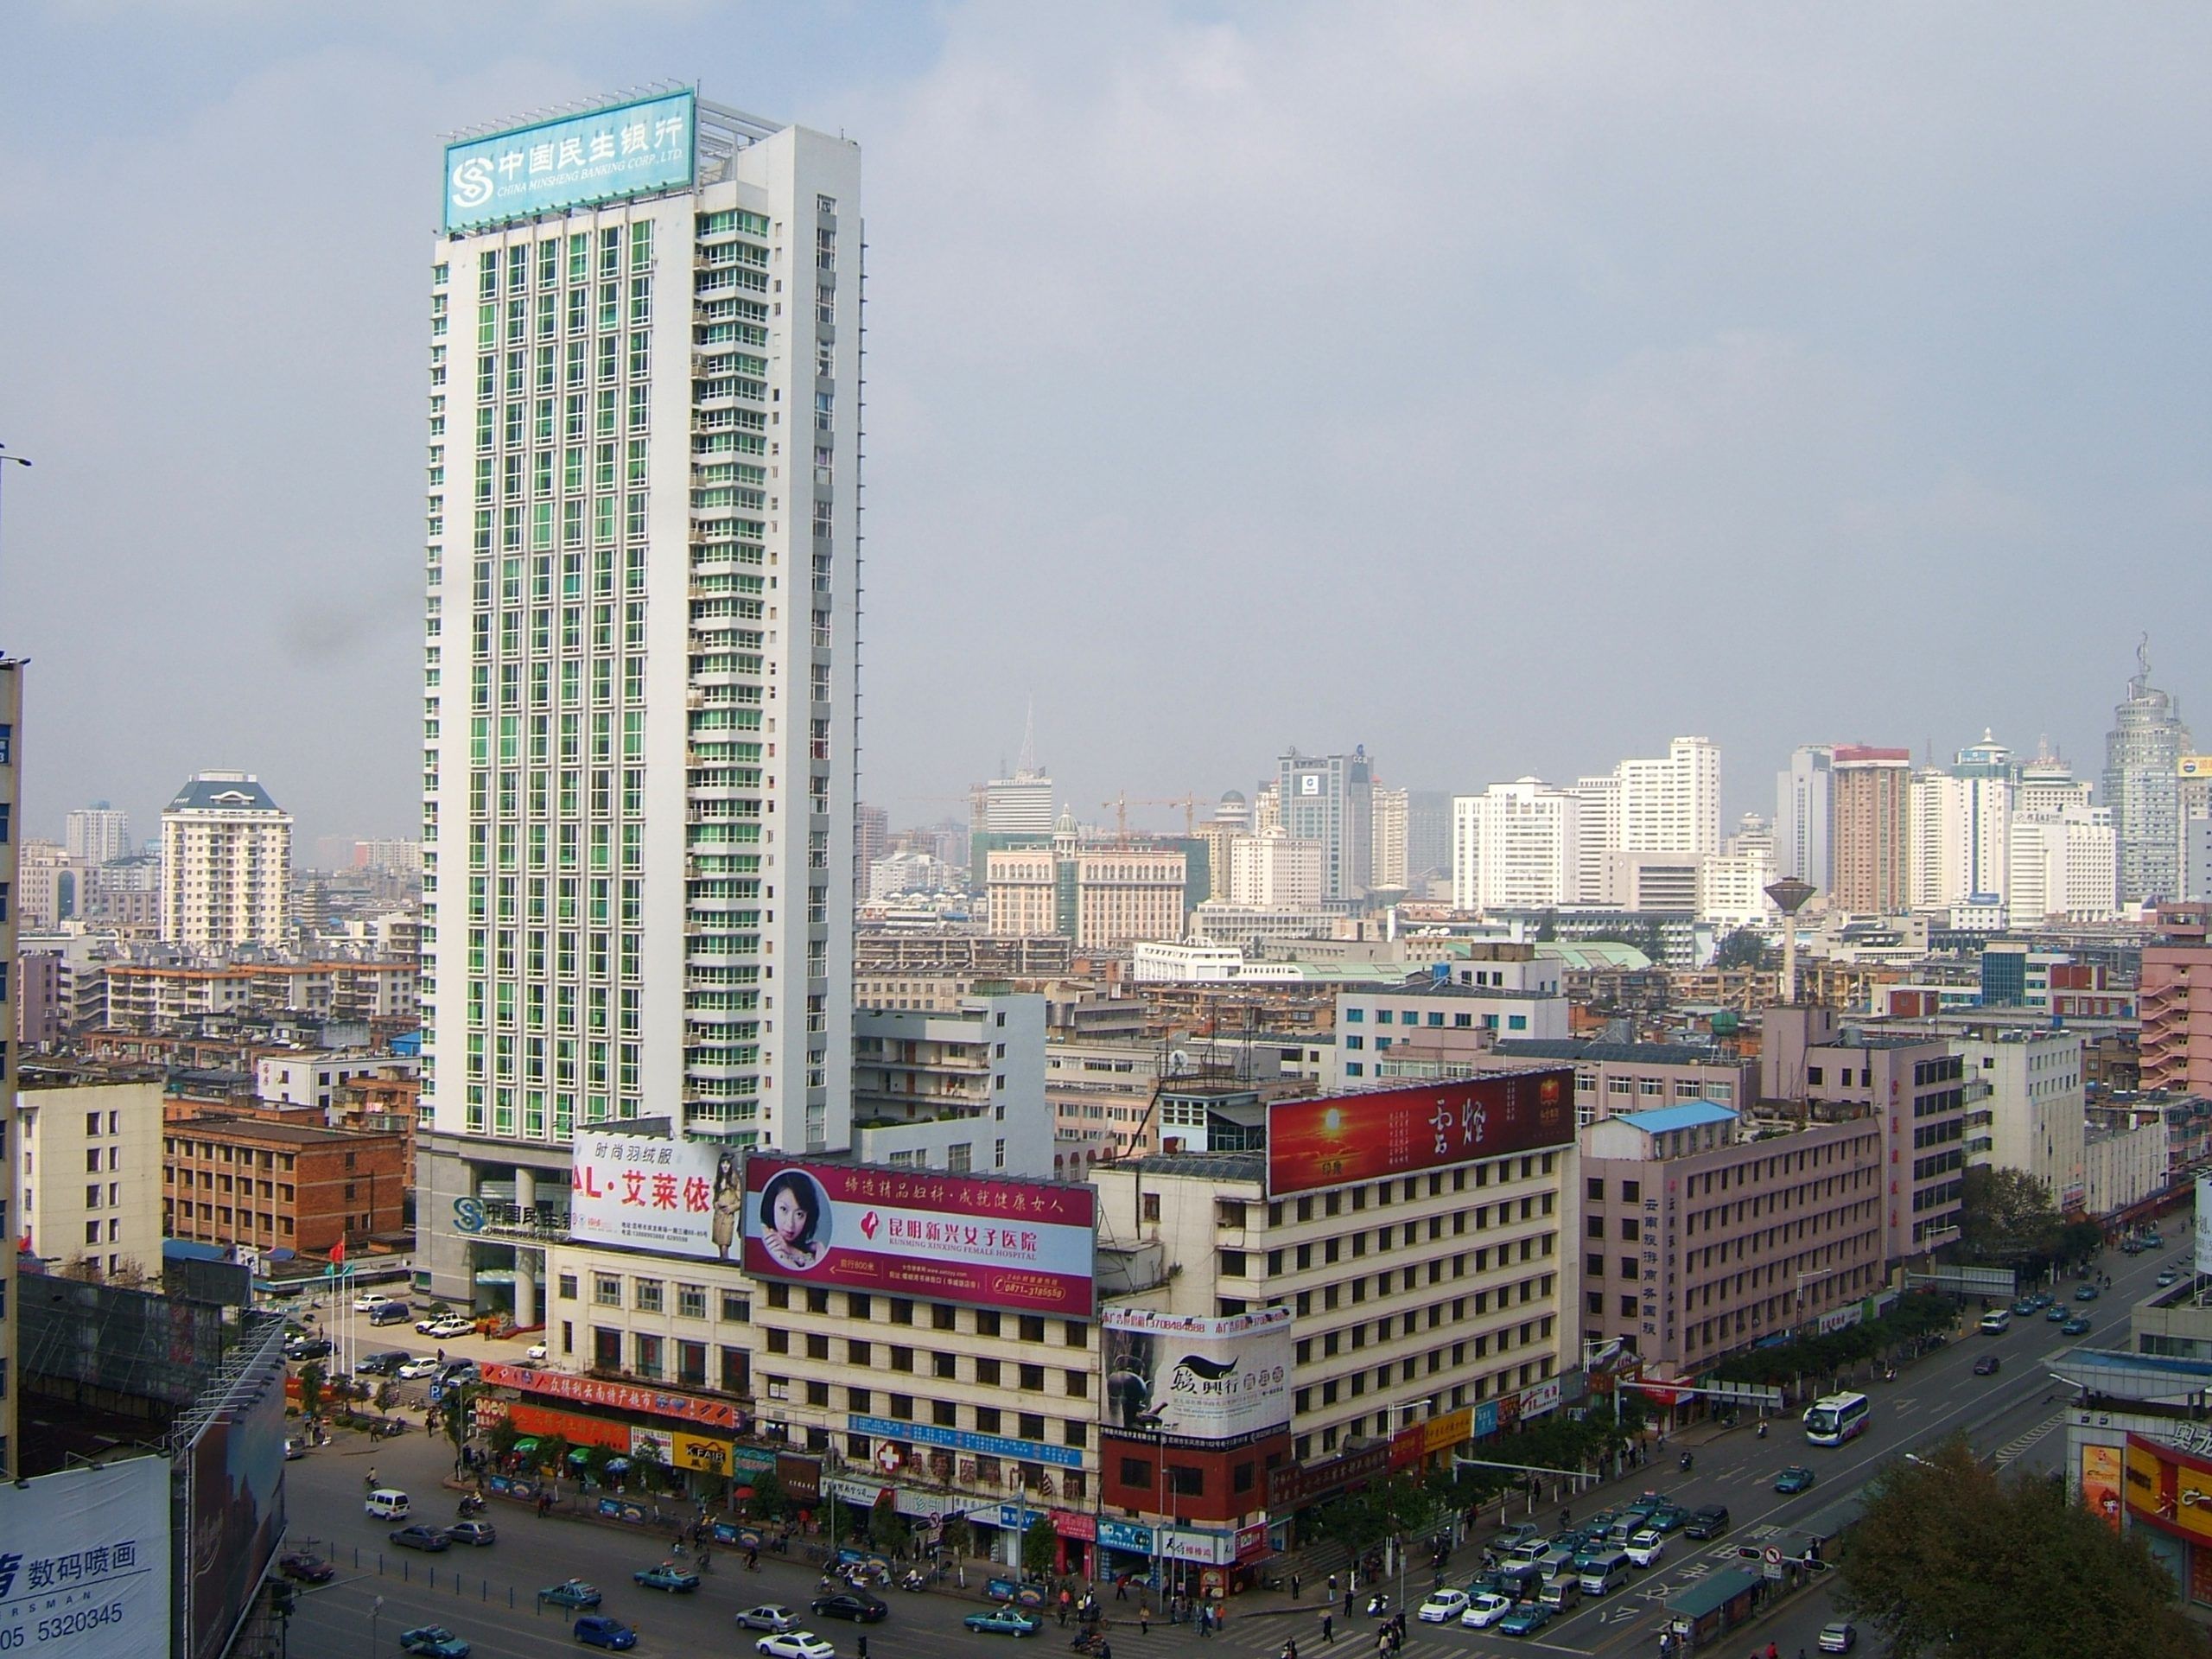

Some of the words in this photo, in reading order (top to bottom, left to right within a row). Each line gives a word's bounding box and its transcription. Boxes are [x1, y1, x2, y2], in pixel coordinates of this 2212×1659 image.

[499, 117, 683, 181] 中国民生银行
[498, 182, 526, 197] CHINA
[528, 173, 579, 191] MINSHENG
[582, 161, 626, 178] BANKING
[594, 1141, 673, 1166] 时尚羽绒服
[888, 1217, 1038, 1252] 昆明新兴女子医院
[889, 1236, 926, 1248] KUNMING
[928, 1242, 963, 1252] XINXING
[963, 1245, 994, 1256] FEMALE
[996, 1248, 1037, 1261] HOSPITAL
[432, 1385, 440, 1395] P
[29, 1540, 137, 1591] 数码喷画
[0, 1591, 91, 1618] RSMAN
[37, 1602, 123, 1642] 5320345
